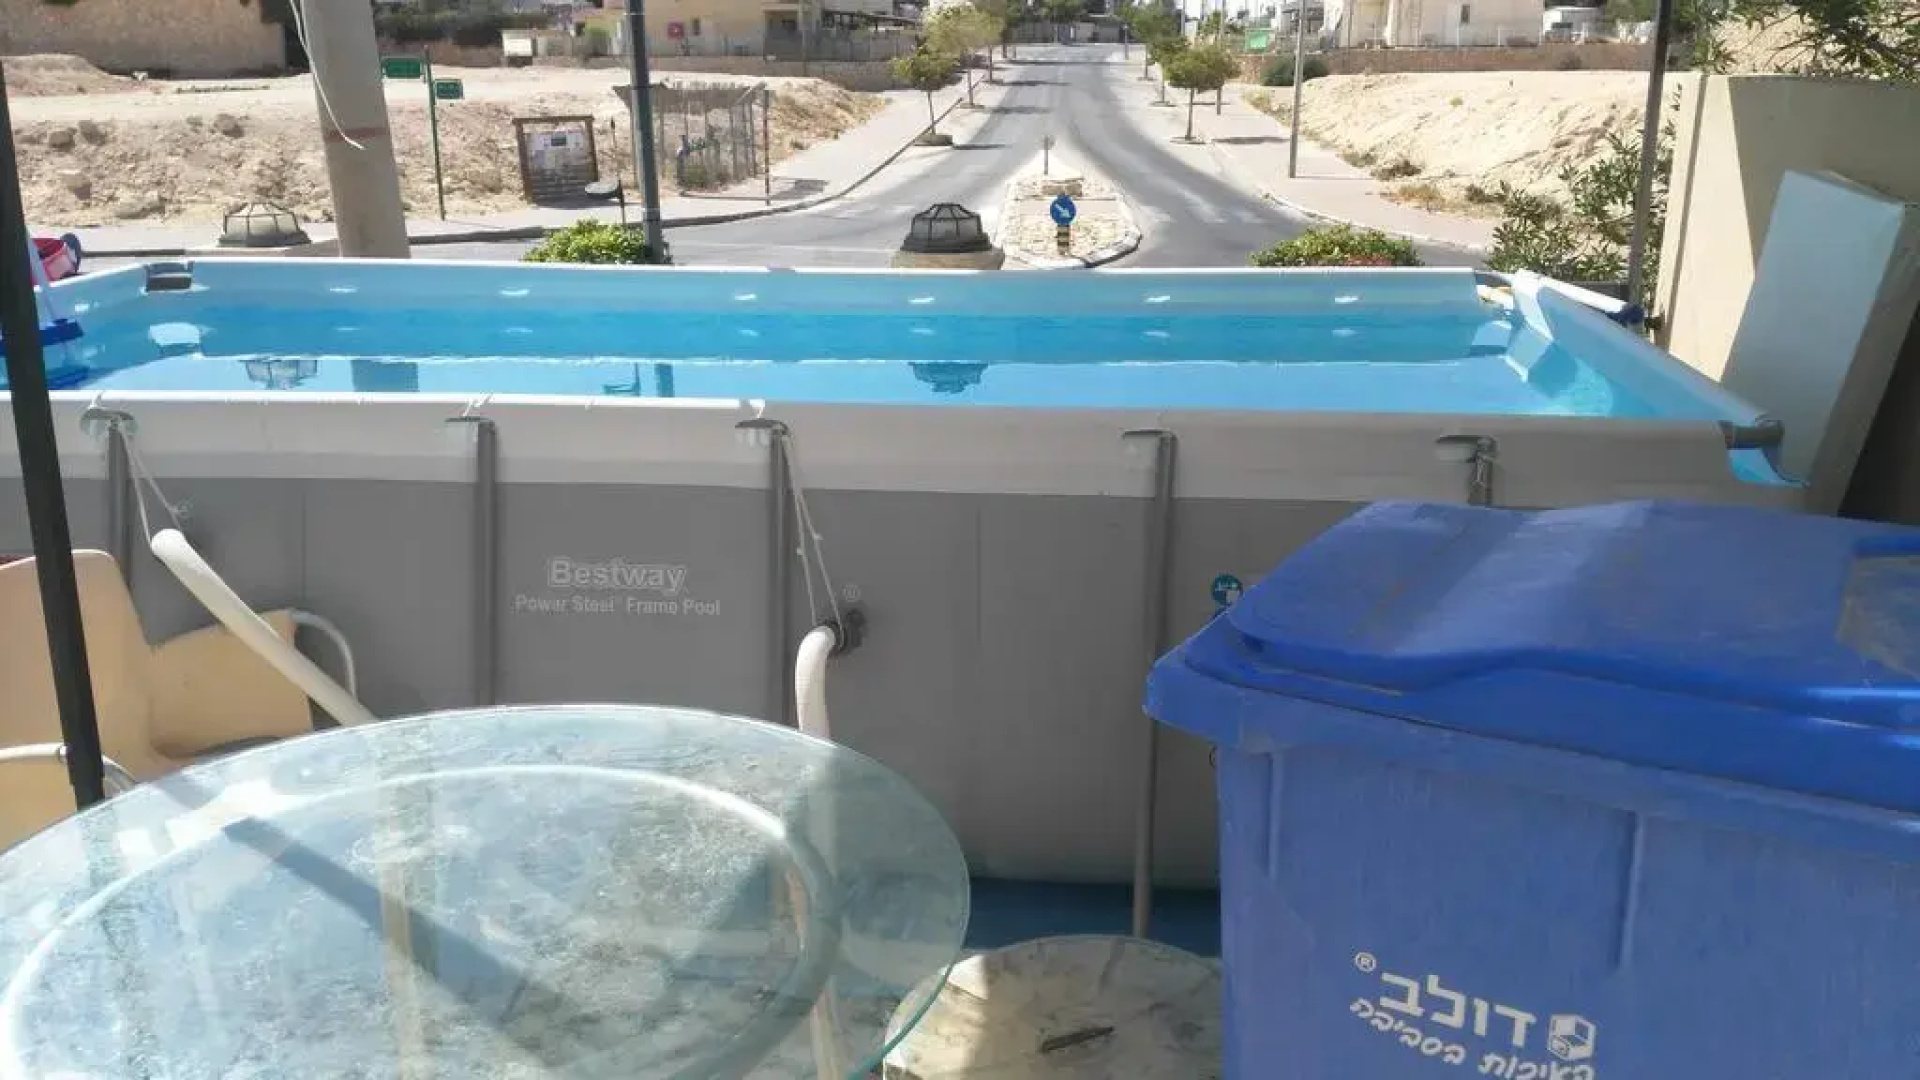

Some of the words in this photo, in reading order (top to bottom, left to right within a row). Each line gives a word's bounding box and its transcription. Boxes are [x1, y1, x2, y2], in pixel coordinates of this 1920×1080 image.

[547, 556, 688, 596] Bestway
[683, 597, 721, 616] Pool
[1379, 972, 1537, 1048] דולב
